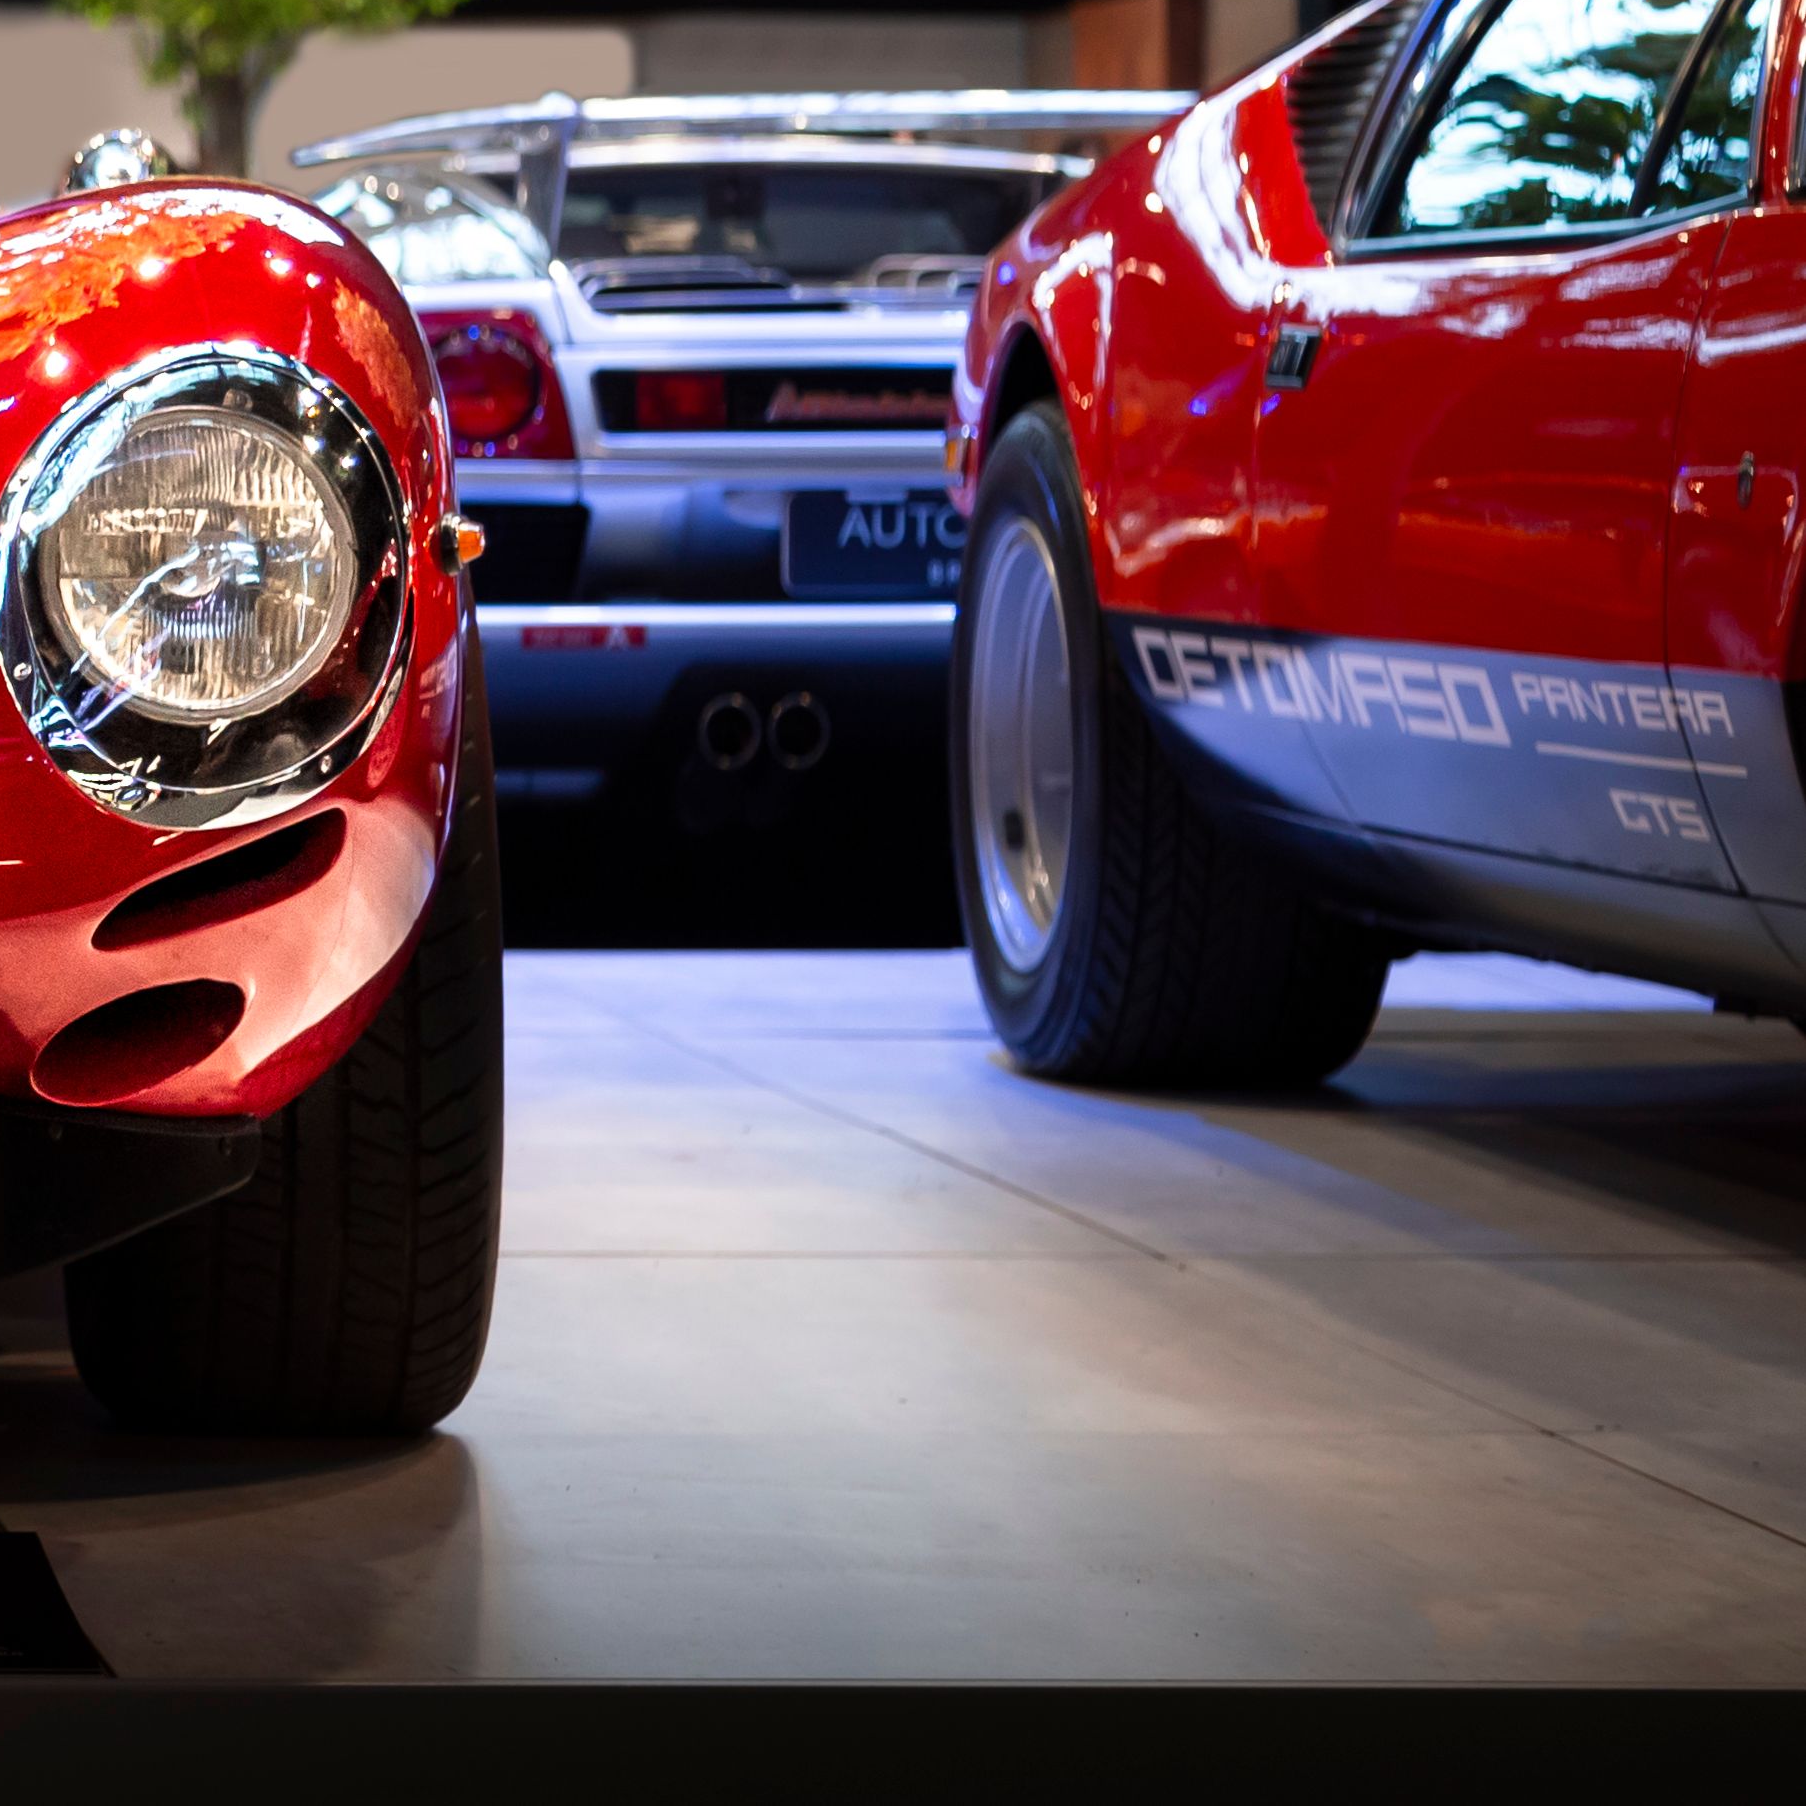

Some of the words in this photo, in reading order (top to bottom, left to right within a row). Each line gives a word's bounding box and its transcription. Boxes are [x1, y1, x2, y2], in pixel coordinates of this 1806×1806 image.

[1133, 626, 1512, 747] DETOMASO
[1512, 672, 1735, 738] PANTERA
[1609, 788, 1711, 843] GTS
